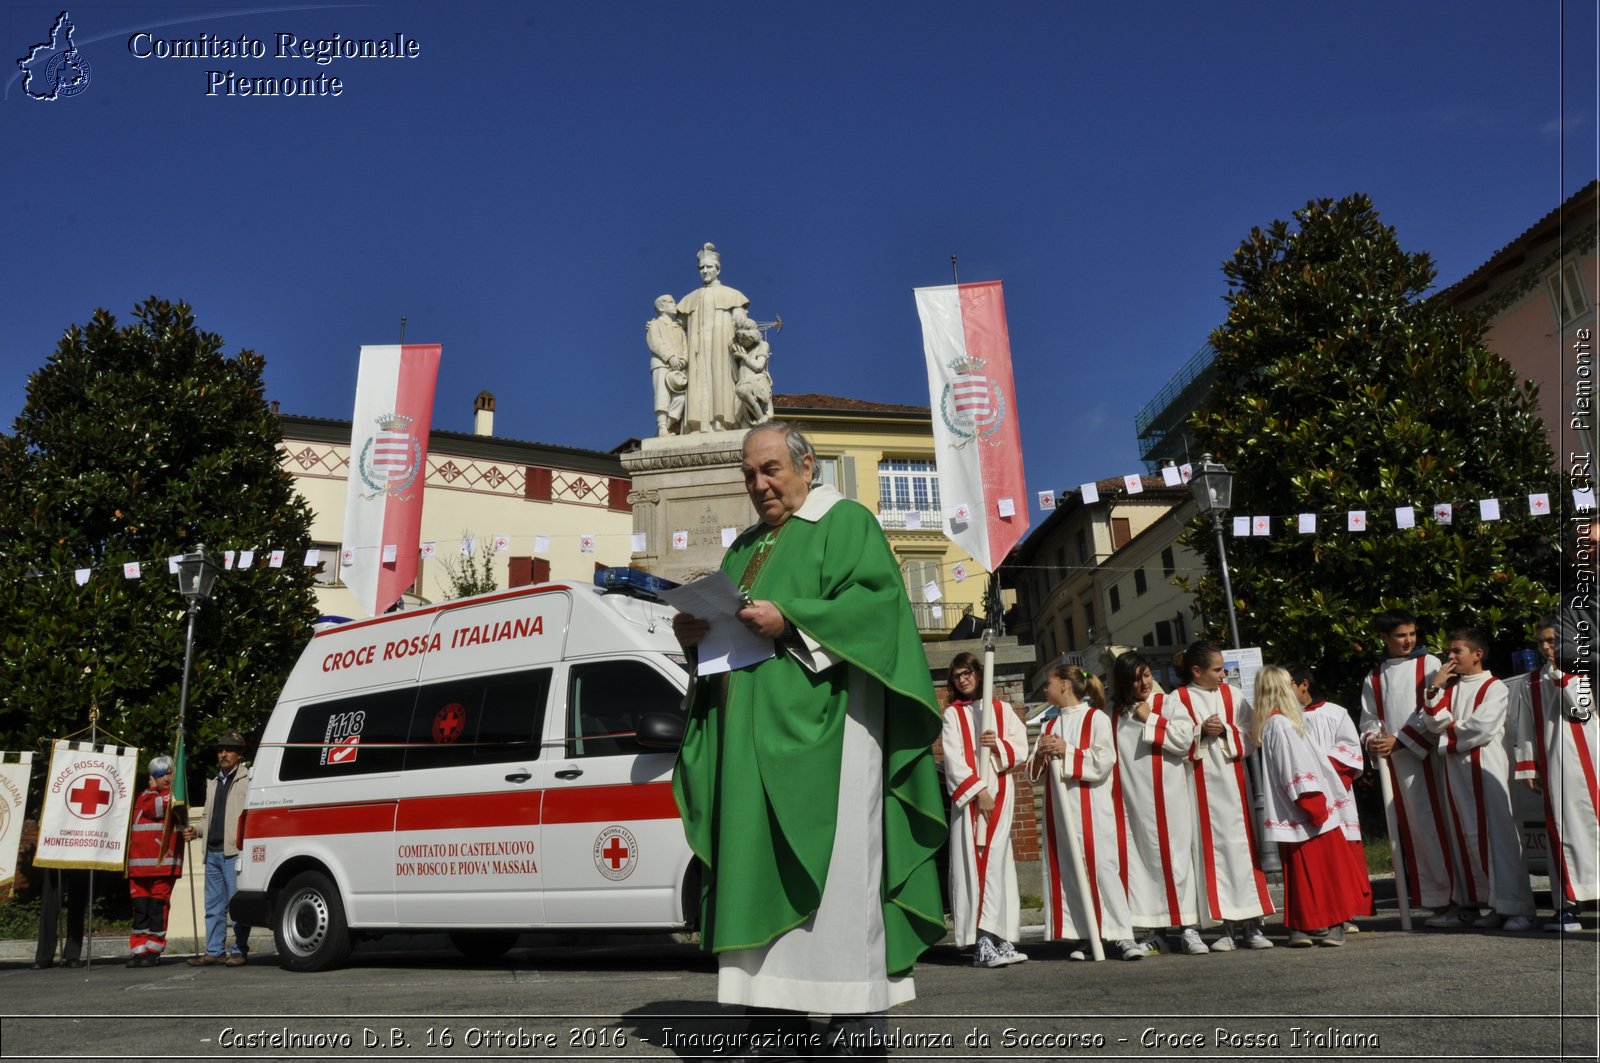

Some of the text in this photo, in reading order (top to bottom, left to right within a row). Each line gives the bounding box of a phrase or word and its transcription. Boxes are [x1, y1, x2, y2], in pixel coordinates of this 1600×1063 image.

[322, 615, 544, 673] CROCE ROSSA ITALIANA
[333, 710, 366, 737] 118
[52, 760, 127, 800] CROCE ROSSA ITALIANA
[59, 829, 84, 837] COMITATO
[84, 830, 103, 838] LOCALE
[43, 837, 121, 851] MONTEGROSSO D'ASTI
[398, 840, 535, 858] COMITATO DI CASTELNUOVO
[396, 859, 538, 876] DON BOSCO E PIOVA' MASSAIA
